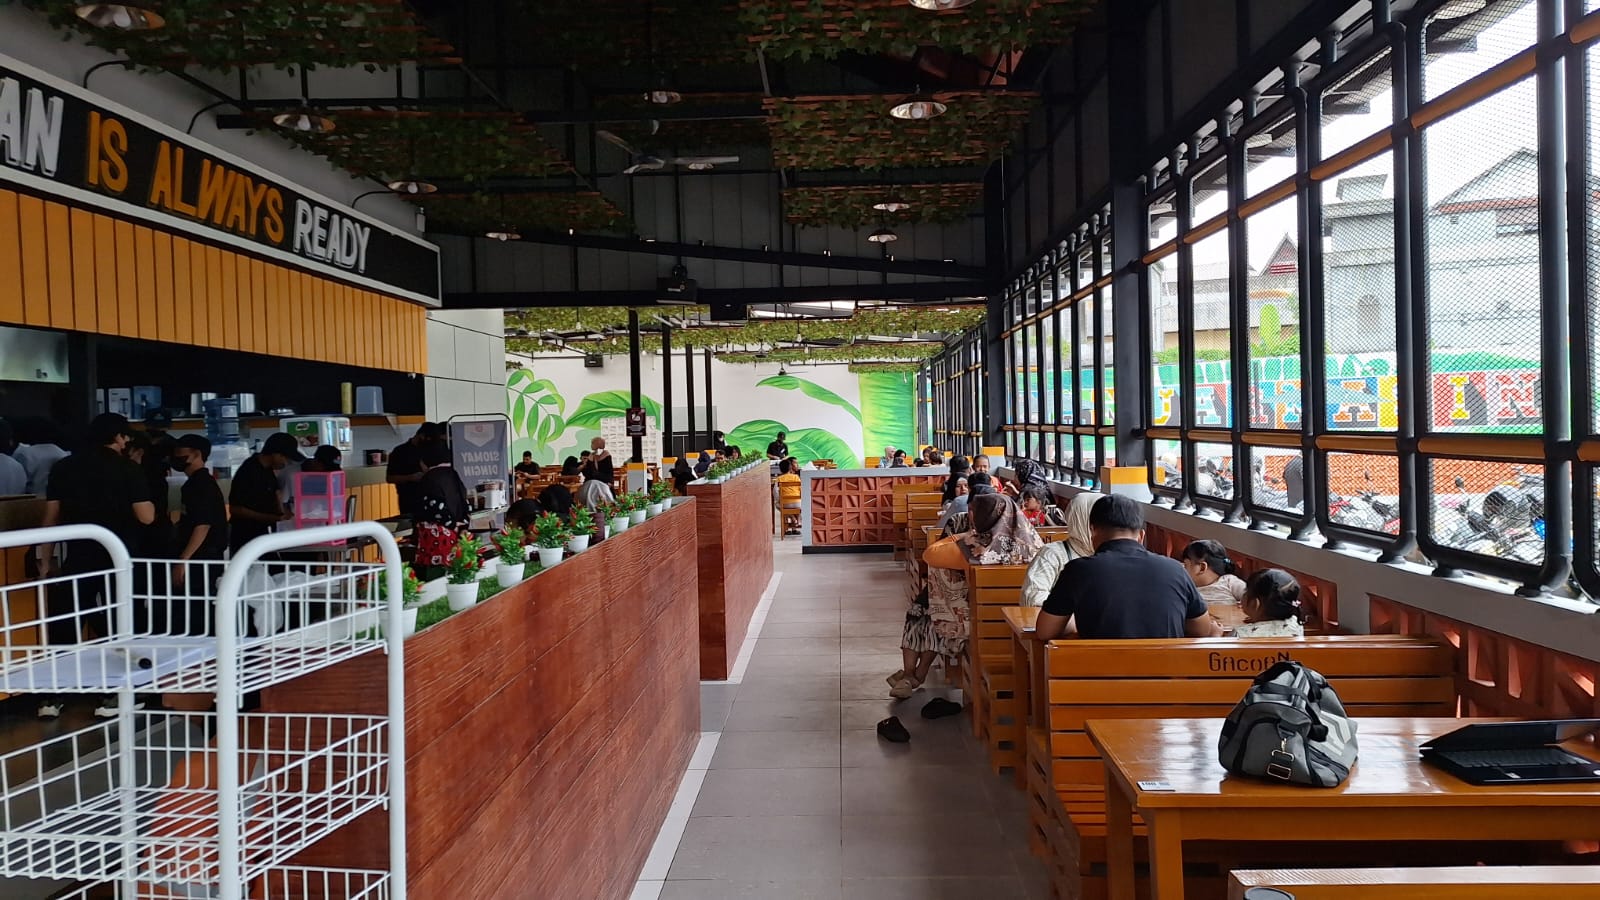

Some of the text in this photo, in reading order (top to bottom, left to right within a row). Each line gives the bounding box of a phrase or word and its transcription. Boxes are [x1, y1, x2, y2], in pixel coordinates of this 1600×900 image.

[86, 109, 129, 195] IS
[147, 139, 285, 245] ALWAYS
[293, 198, 371, 274] READY
